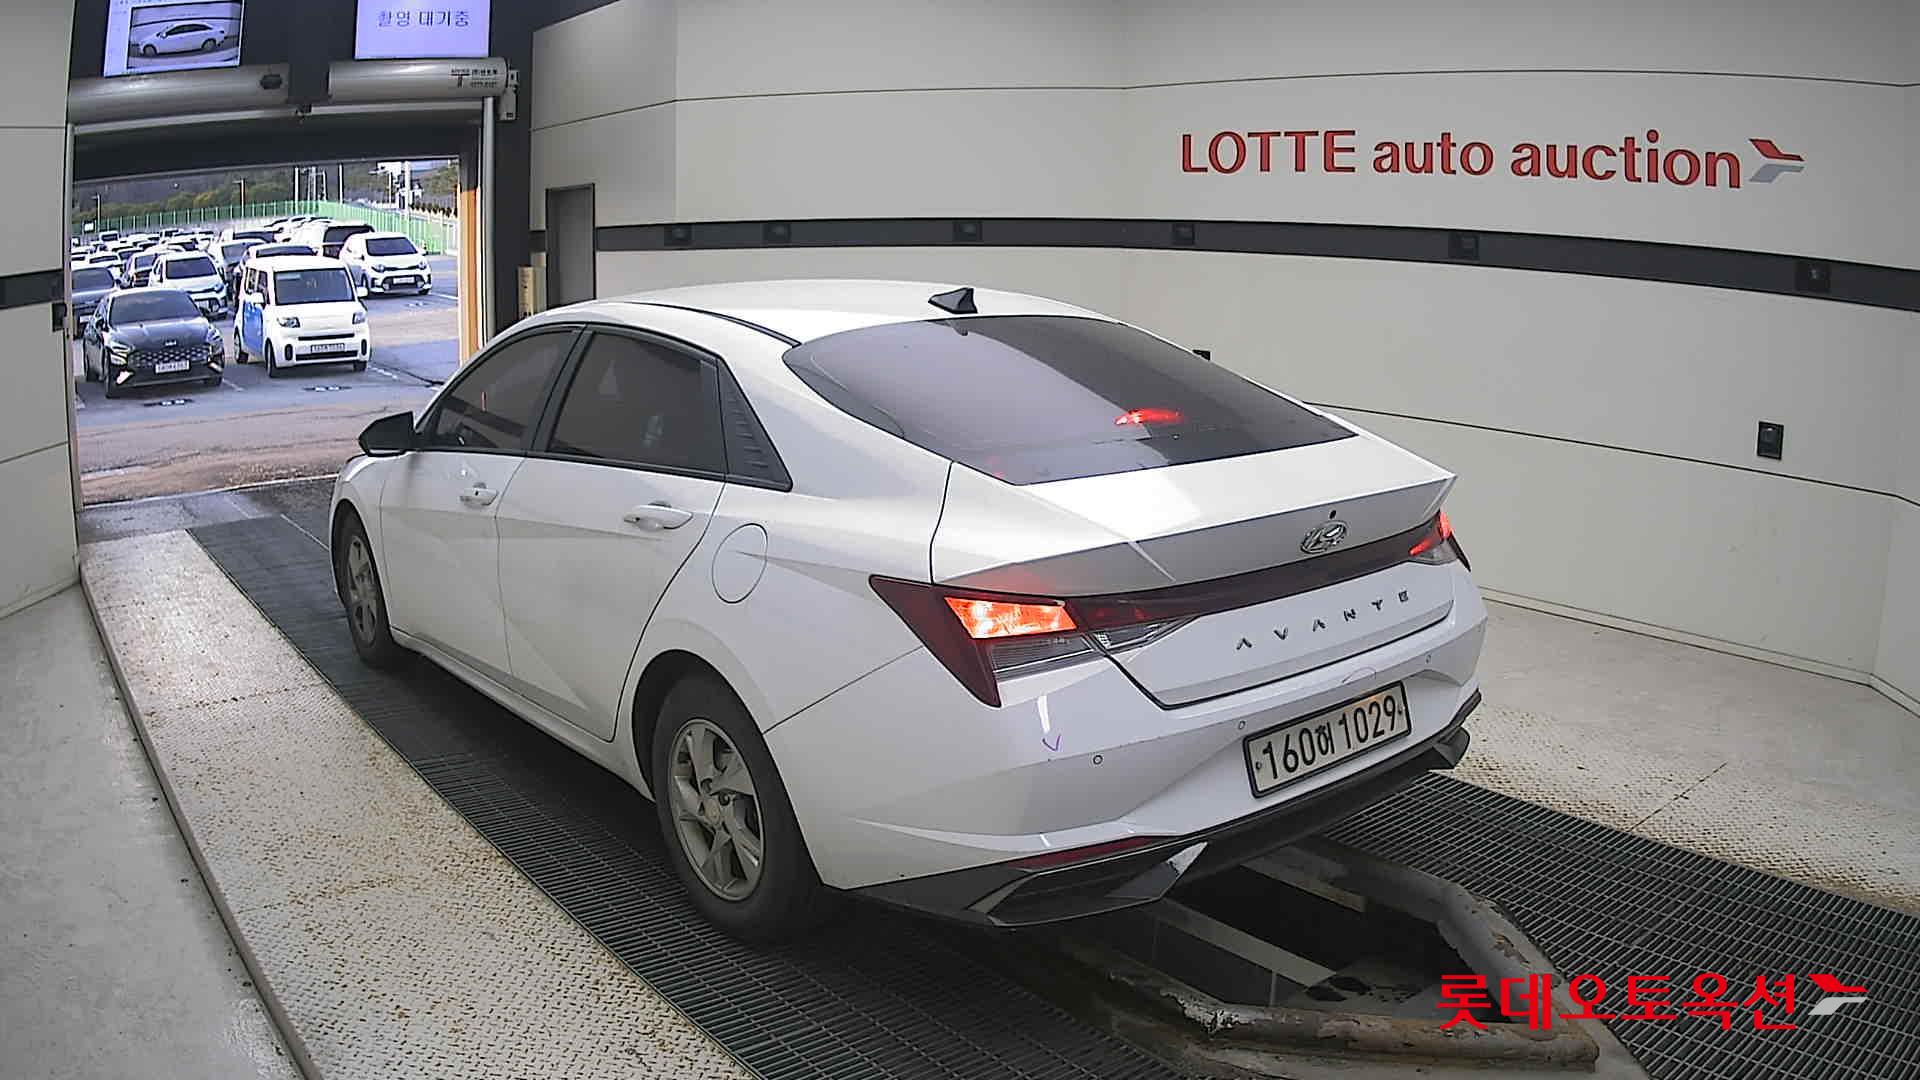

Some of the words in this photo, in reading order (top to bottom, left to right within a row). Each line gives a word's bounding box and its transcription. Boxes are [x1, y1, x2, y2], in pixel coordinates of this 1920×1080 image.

[419, 10, 469, 27] 대기중
[1181, 130, 1356, 174] LOTTE
[1372, 132, 1494, 176] auto
[1511, 129, 1741, 189] auction
[1262, 721, 1335, 780] 160허
[1338, 695, 1397, 750] 1029
